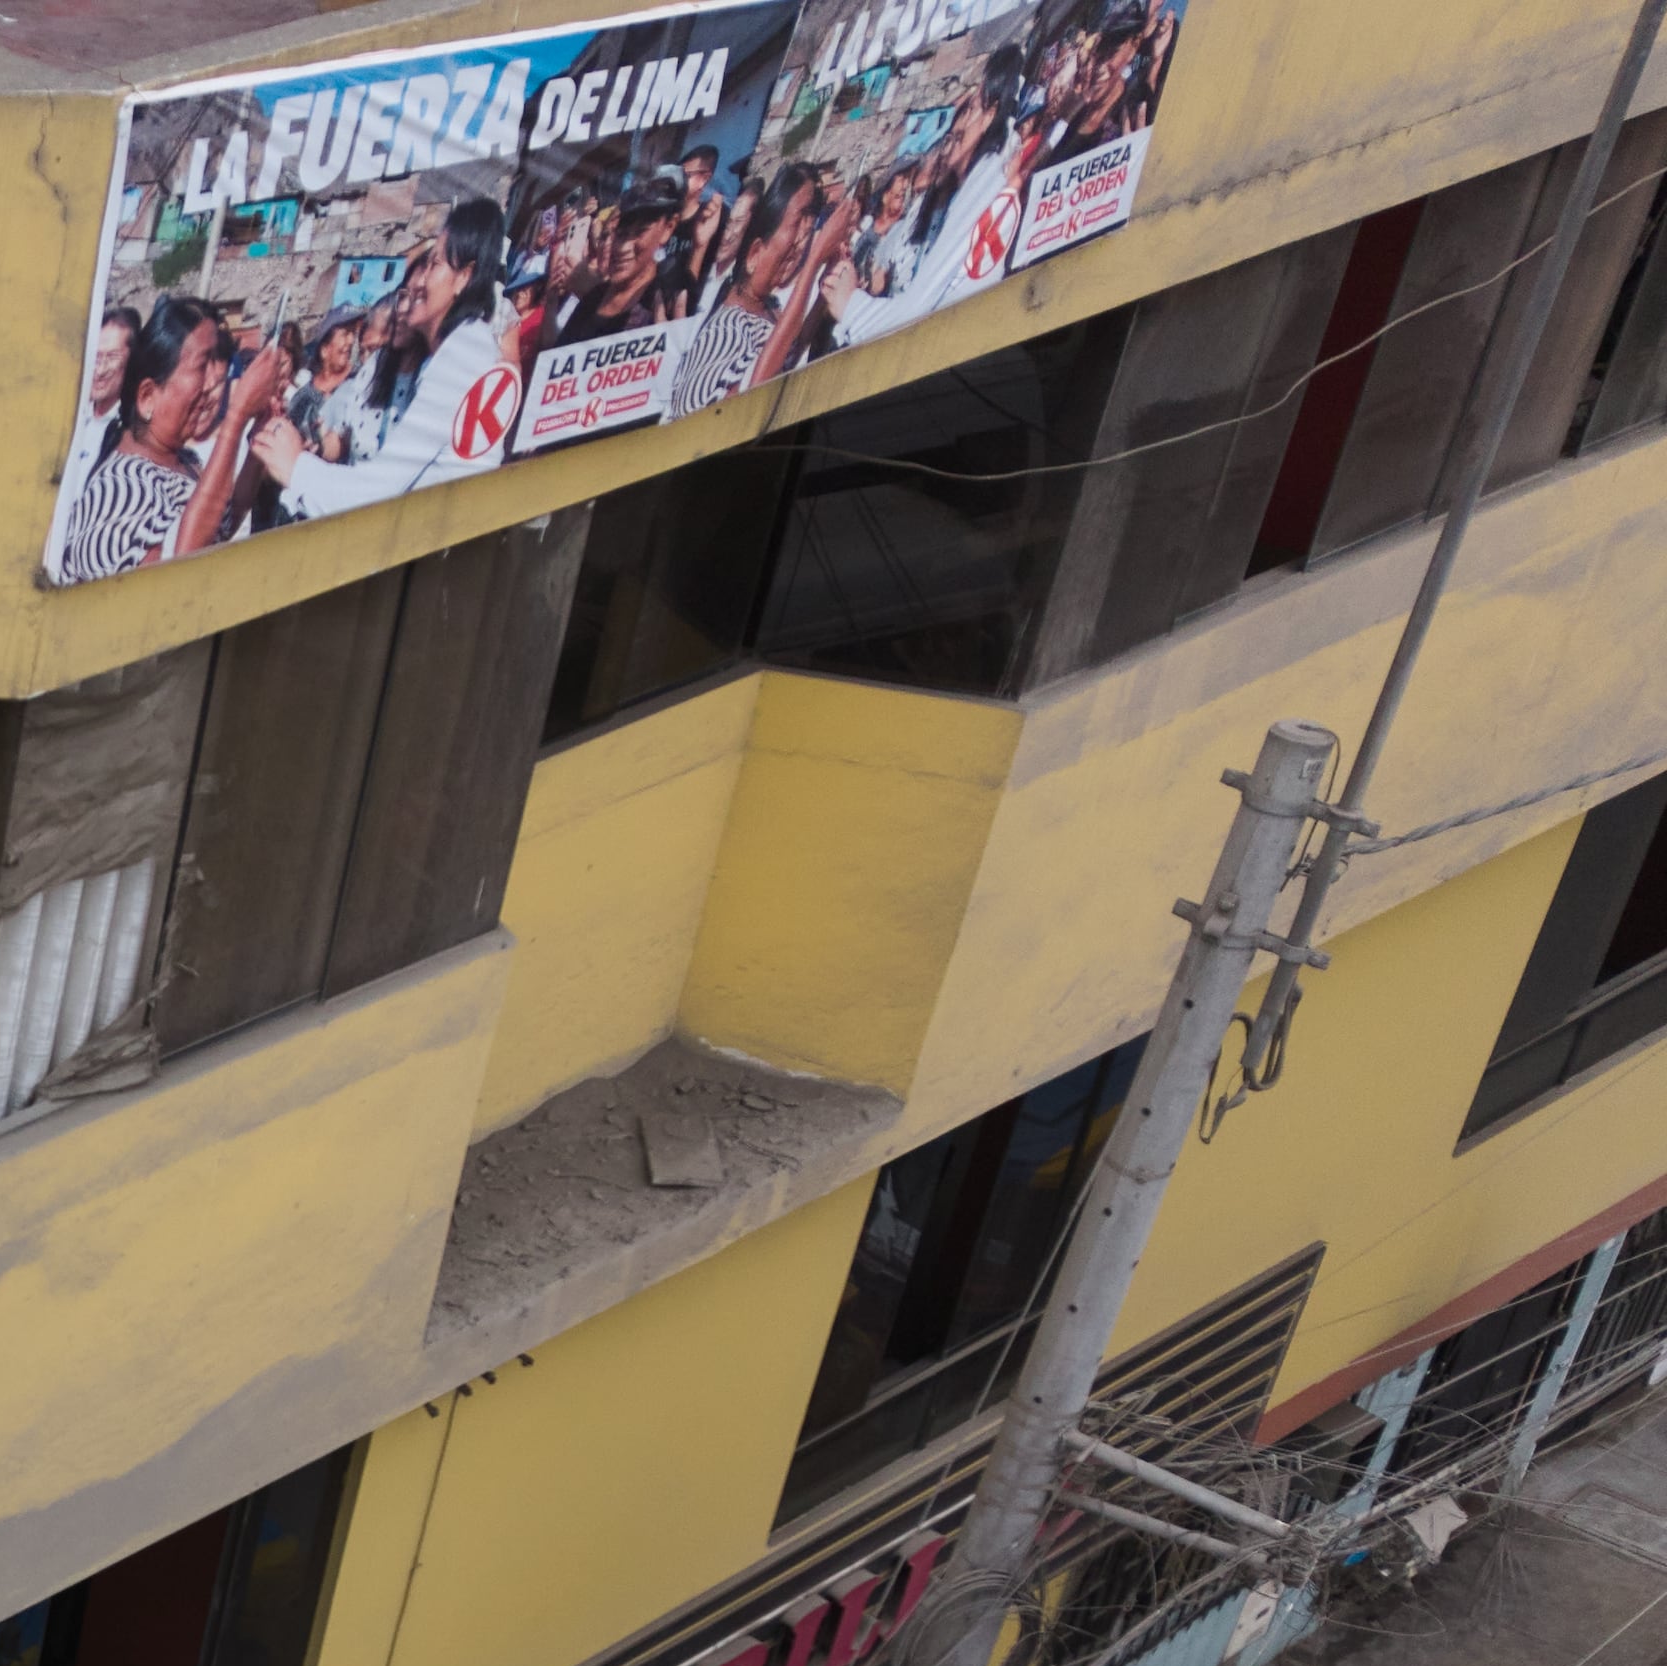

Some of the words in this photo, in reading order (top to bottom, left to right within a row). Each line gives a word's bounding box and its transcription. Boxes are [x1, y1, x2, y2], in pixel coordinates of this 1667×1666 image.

[183, 130, 251, 215] LA
[254, 57, 531, 200] FUERZA
[528, 66, 608, 150] DE
[596, 47, 730, 136] LIMA
[1035, 194, 1063, 222] DEL
[1070, 165, 1128, 206] ORDEN
[1041, 173, 1062, 199] LA
[1066, 144, 1132, 188] FUERZA
[541, 382, 578, 406] DEL
[587, 356, 663, 393] ORDEN
[549, 355, 573, 380] LA
[582, 332, 666, 372] FUERZA
[455, 369, 514, 459] K
